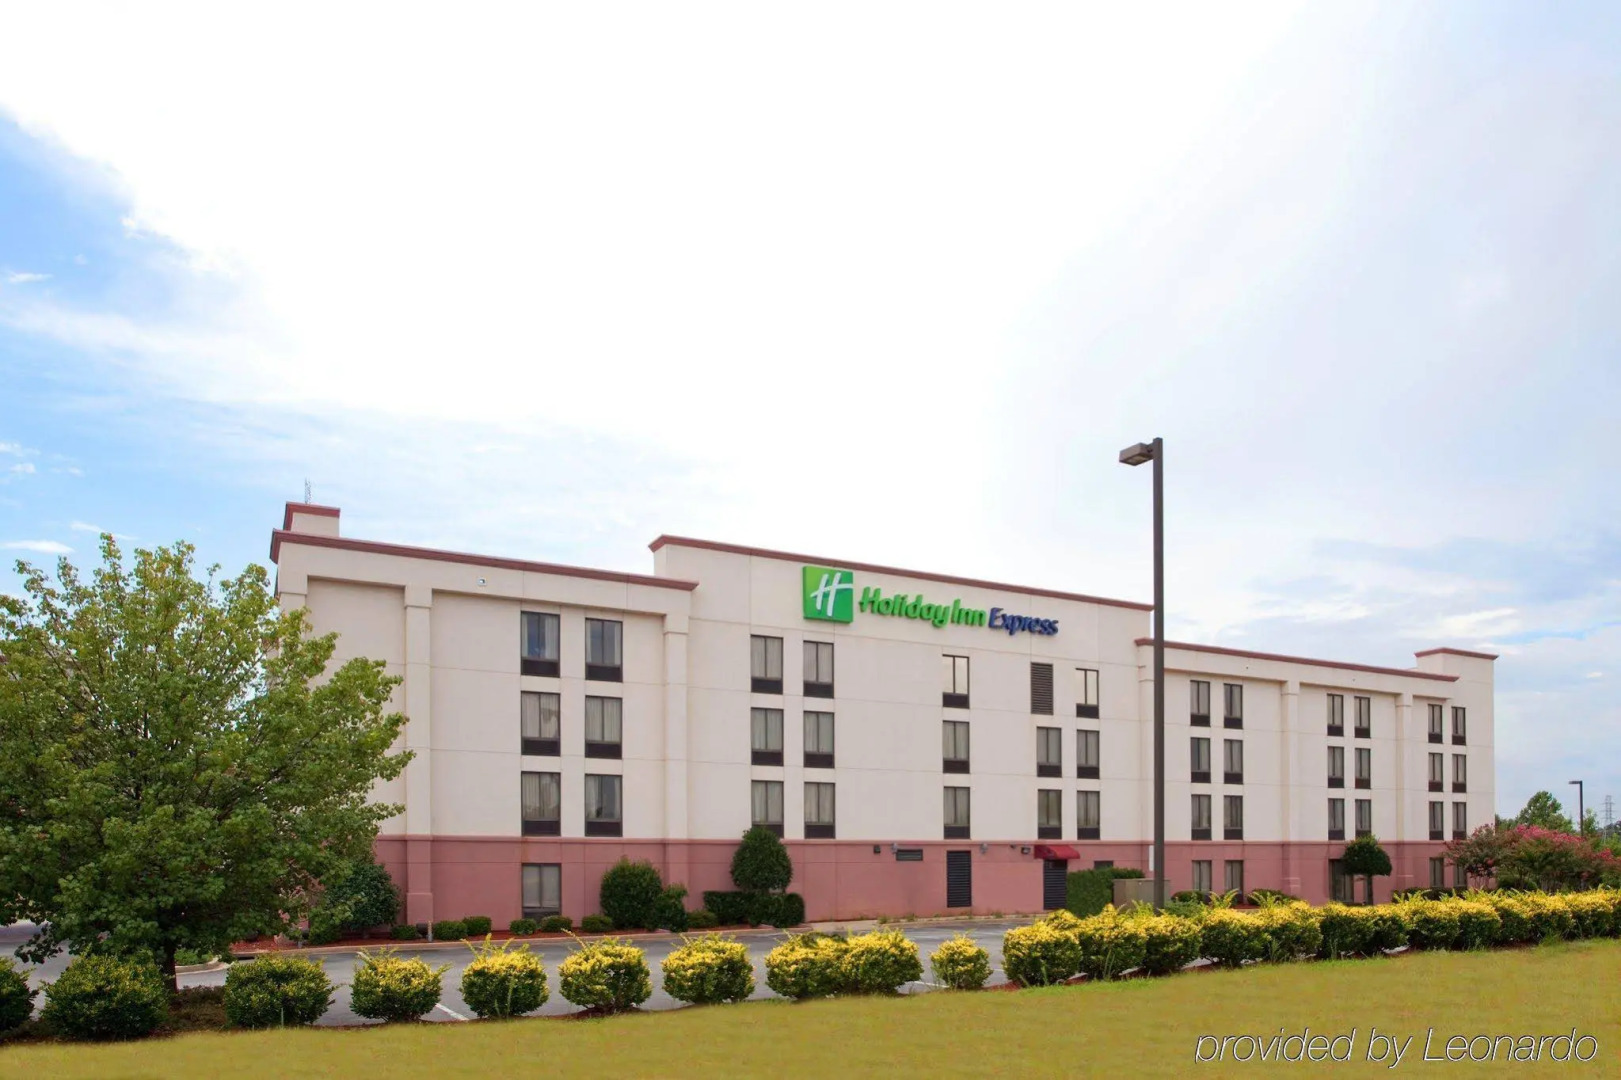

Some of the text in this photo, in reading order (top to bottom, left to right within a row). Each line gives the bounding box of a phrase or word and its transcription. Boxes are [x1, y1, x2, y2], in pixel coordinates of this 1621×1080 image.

[859, 586, 1059, 636] Holiday Inn Express
